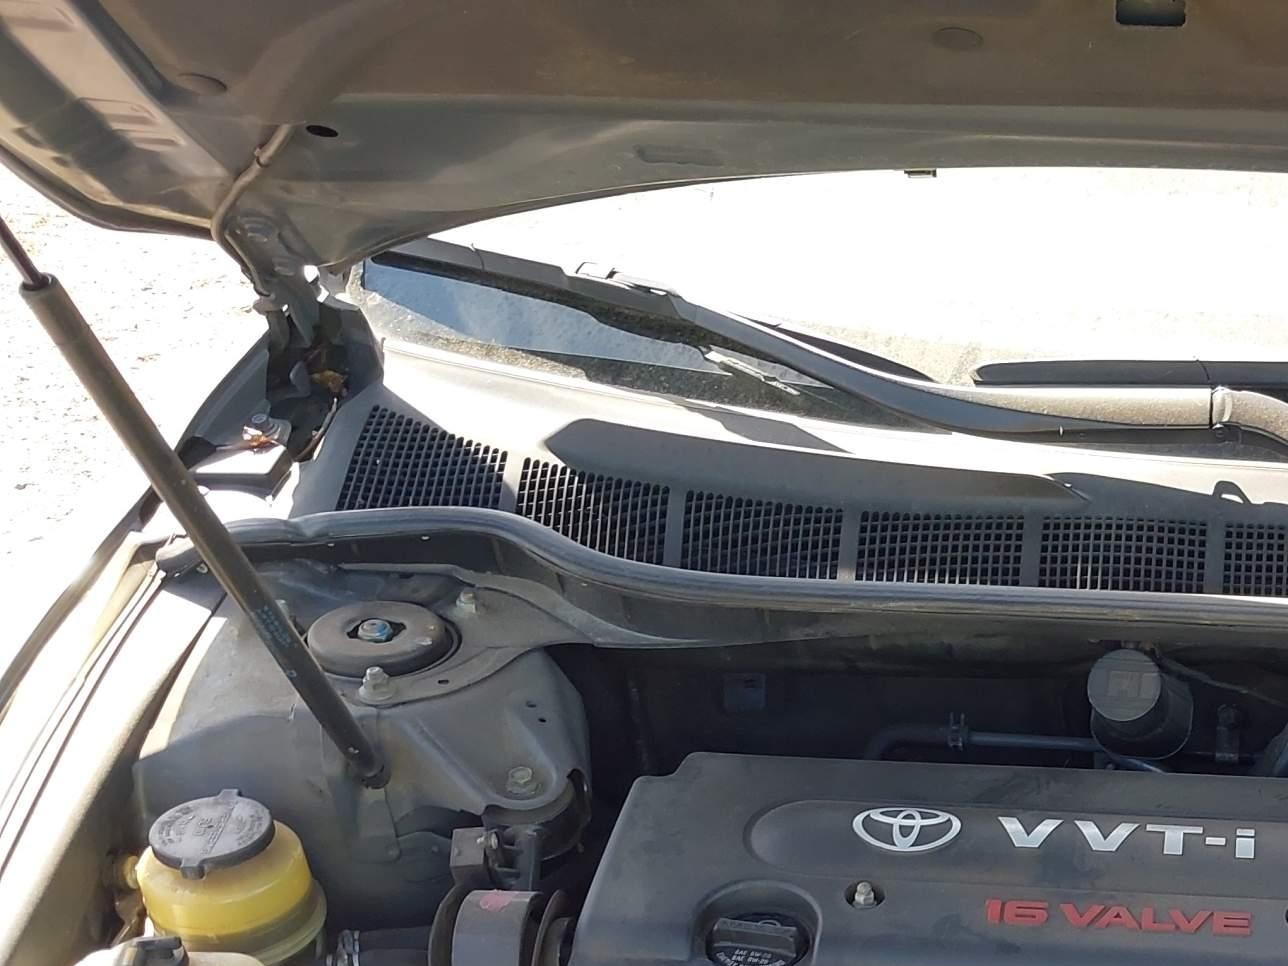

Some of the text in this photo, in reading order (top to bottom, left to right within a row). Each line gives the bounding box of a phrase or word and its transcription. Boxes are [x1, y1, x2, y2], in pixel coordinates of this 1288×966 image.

[998, 816, 1256, 859] VVT-i
[986, 898, 1253, 936] 16 VALVE
